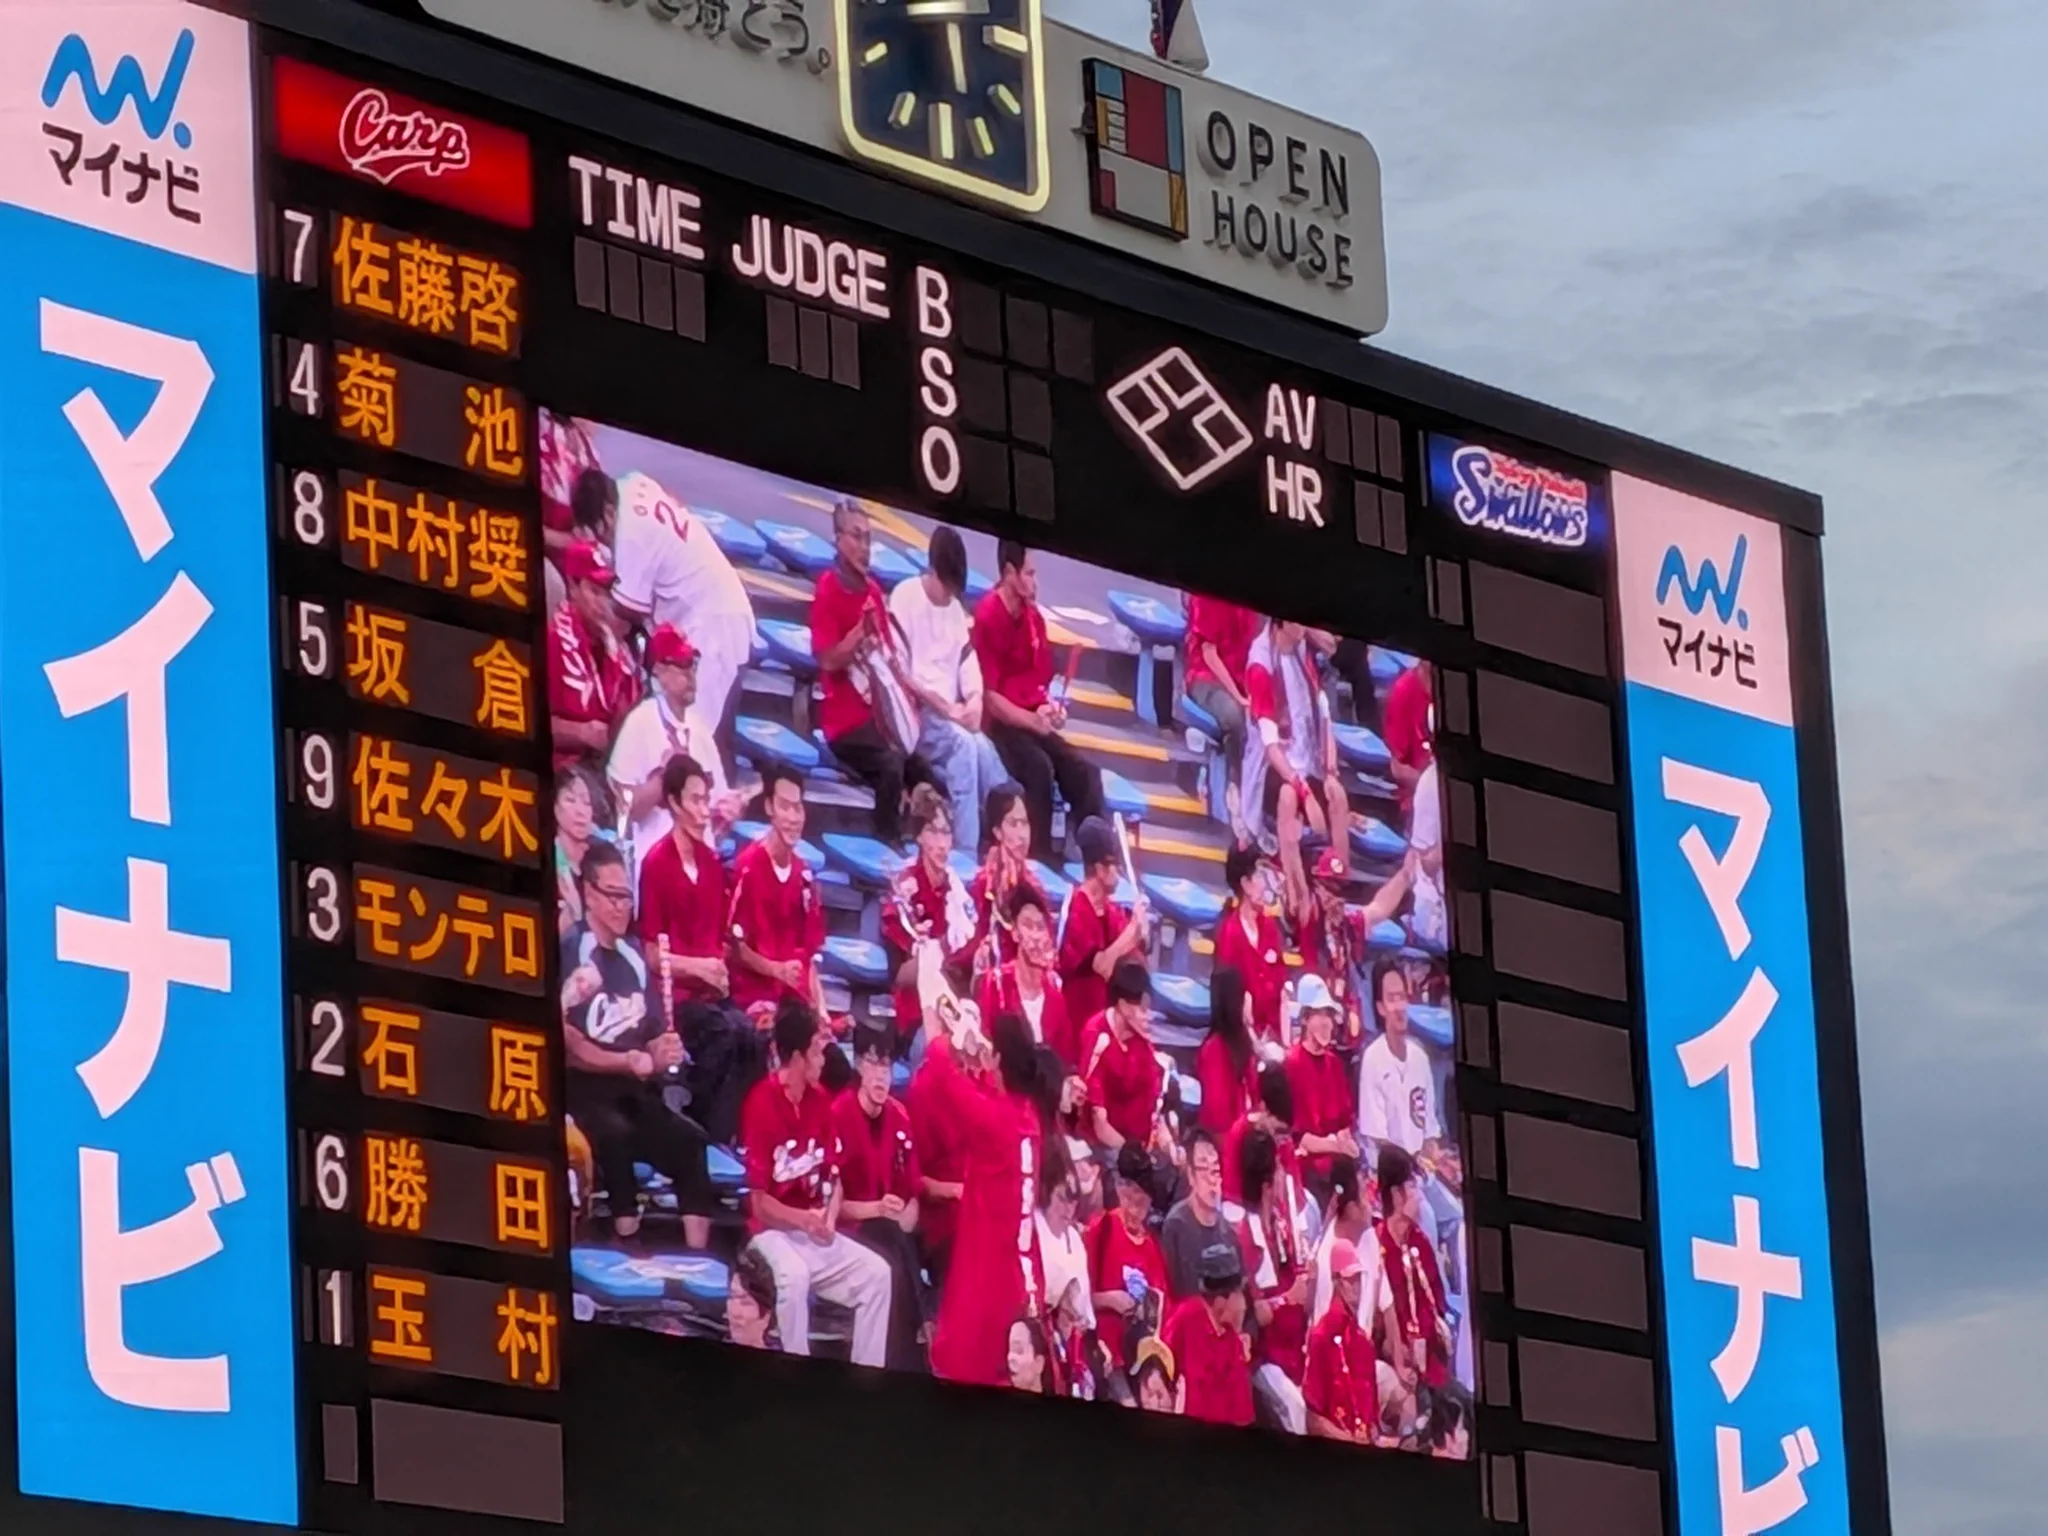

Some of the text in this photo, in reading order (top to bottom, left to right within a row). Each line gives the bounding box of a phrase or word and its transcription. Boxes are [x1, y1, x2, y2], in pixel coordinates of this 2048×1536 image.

[42, 122, 202, 224] マイナビ
[339, 88, 470, 184] Carp
[1207, 111, 1349, 214] OPEN
[568, 155, 890, 319] TIME JUDGE
[1211, 190, 1354, 288] HOUSE
[284, 209, 518, 351] 7 佐藤啓
[916, 265, 952, 339] B
[290, 343, 319, 415] 4
[920, 347, 958, 418] S
[1264, 382, 1316, 451] AV
[920, 425, 961, 494] O
[1265, 455, 1325, 528] HR
[293, 470, 527, 607] 8 中村奨
[299, 601, 327, 676] 5
[1658, 617, 1759, 690] マイナビ
[303, 733, 539, 859] 9 佐々木
[39, 297, 246, 1413] マイナビ
[307, 866, 538, 978] 3 モンテロ
[311, 1000, 345, 1077] 2
[315, 1134, 349, 1210] 6
[325, 1269, 342, 1346] 1
